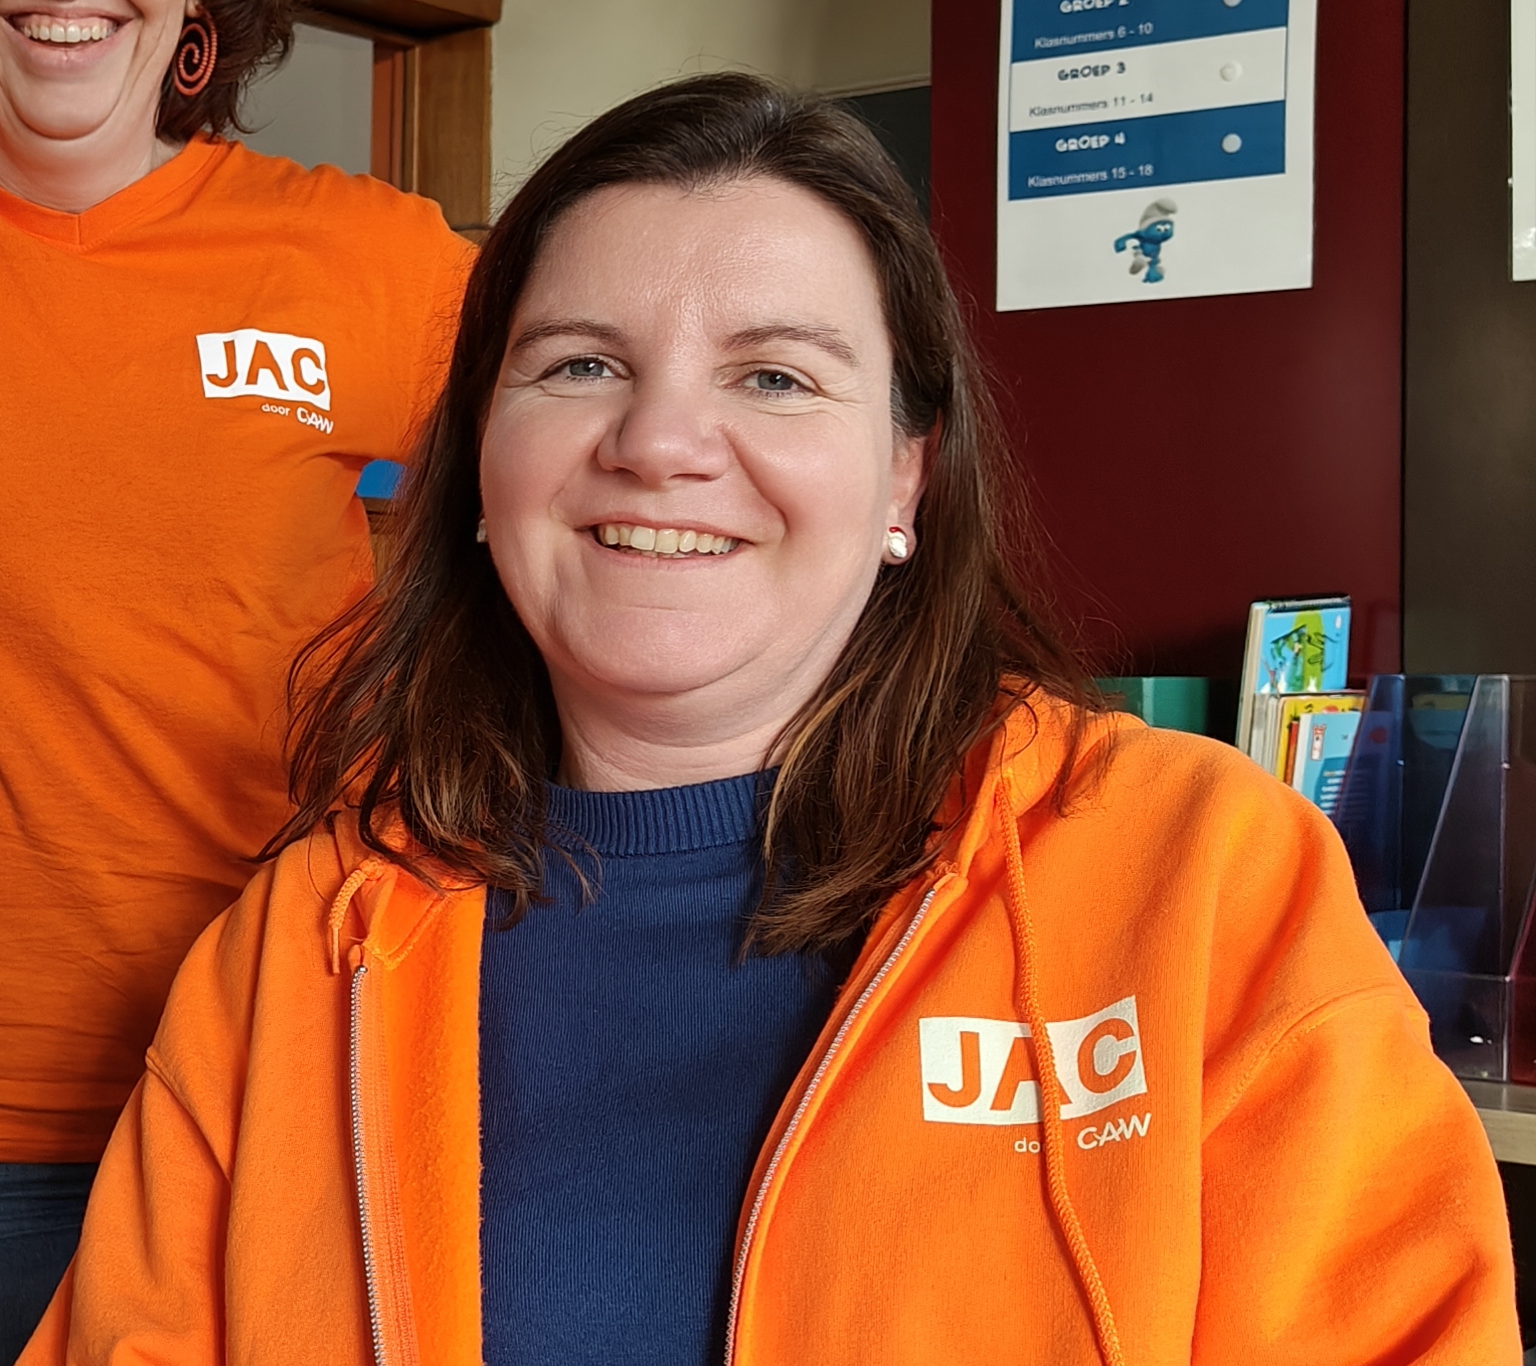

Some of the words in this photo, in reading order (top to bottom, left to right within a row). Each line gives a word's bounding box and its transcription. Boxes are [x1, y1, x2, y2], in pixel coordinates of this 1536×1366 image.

[1034, 30, 1115, 49] Klasnummers
[1117, 25, 1127, 39] 6
[1138, 22, 1154, 35] 10
[1057, 64, 1111, 81] GROEP
[1116, 62, 1126, 74] 3
[1029, 99, 1108, 117] Klasnummers
[1113, 95, 1126, 107] 11
[1140, 92, 1154, 104] 14
[1055, 134, 1110, 152] GROEP
[1114, 132, 1126, 145] 4
[1027, 169, 1108, 188] Klasnummers
[1111, 166, 1126, 179] 15
[1138, 164, 1154, 176] 18
[205, 339, 326, 396] JAC
[261, 403, 291, 416] door
[296, 406, 334, 435] CAW
[927, 1017, 1138, 1112] JAC
[1077, 1112, 1152, 1150] CAW
